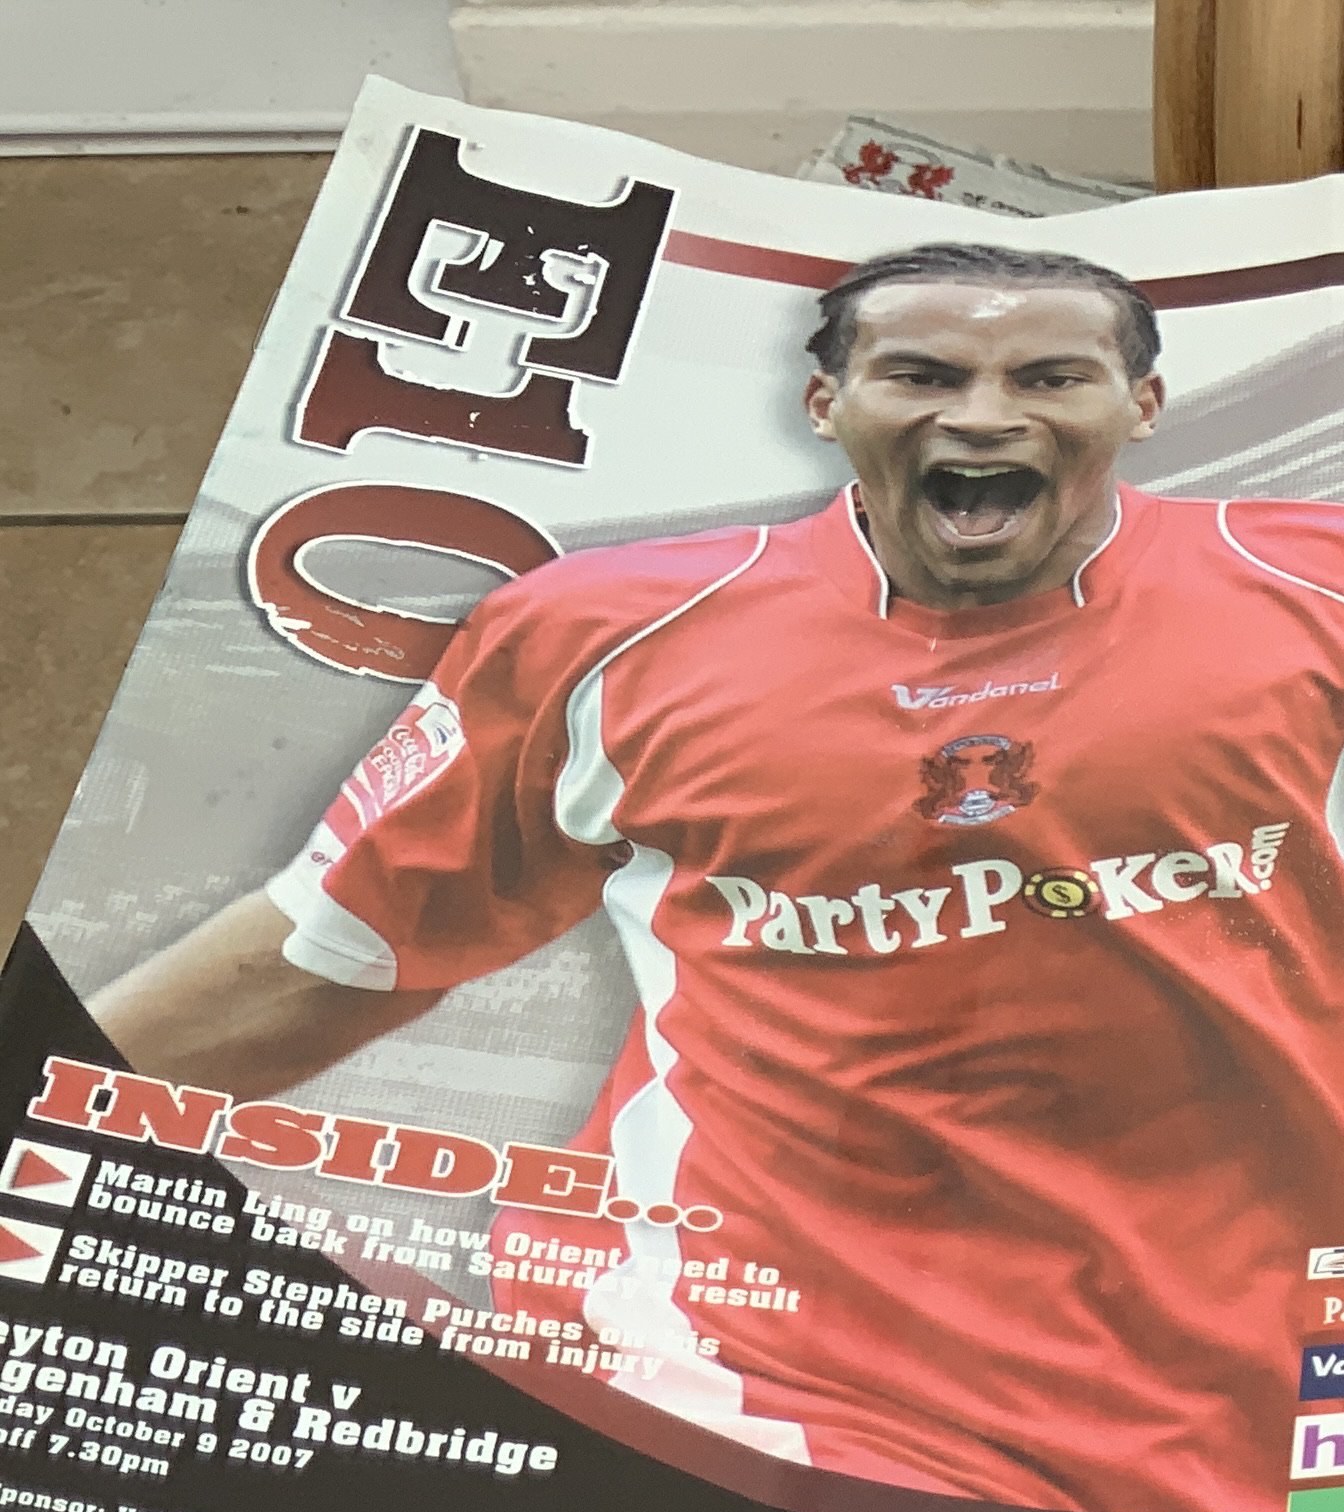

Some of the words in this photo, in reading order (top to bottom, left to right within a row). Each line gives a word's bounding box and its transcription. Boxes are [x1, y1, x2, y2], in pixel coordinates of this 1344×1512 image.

[27, 1055, 725, 1233] INSIDE...
[87, 1183, 236, 1235] bounce
[250, 1216, 348, 1256] back
[360, 1235, 453, 1271] from
[688, 1283, 801, 1313] result
[97, 1159, 228, 1209] Martin
[242, 1188, 332, 1234] Ling
[346, 1213, 393, 1238] on
[408, 1218, 491, 1252] how
[503, 1231, 623, 1269] Orient
[743, 1262, 780, 1286] to
[58, 1262, 188, 1307] return
[202, 1287, 244, 1317] to
[258, 1298, 324, 1331] the
[338, 1313, 425, 1346] side
[439, 1324, 532, 1360] from
[546, 1340, 664, 1381] injury
[67, 1233, 229, 1289] Skipper
[242, 1268, 408, 1318] Stephen
[421, 1297, 584, 1341] Purches
[148, 1345, 311, 1403] Orient
[330, 1383, 363, 1411] v
[47, 1432, 170, 1478] 7.30pm
[64, 1406, 187, 1449] October
[195, 1432, 219, 1455] 9
[226, 1437, 316, 1470] 2007
[238, 1397, 276, 1433] &
[292, 1406, 559, 1475] Redbridge
